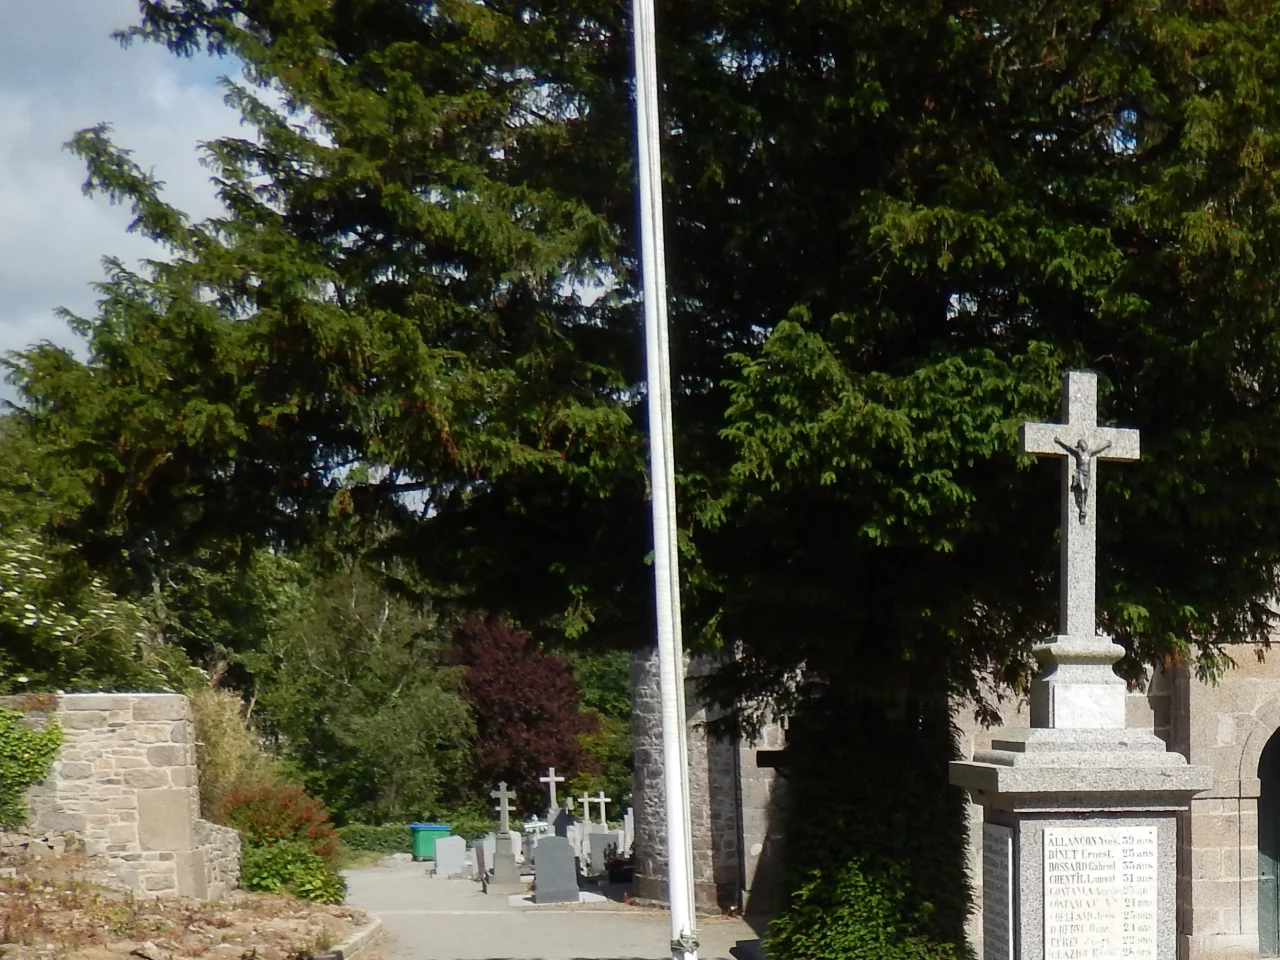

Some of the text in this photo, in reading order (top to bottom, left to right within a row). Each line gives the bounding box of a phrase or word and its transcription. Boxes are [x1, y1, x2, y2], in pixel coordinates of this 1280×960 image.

[1122, 849, 1135, 858] 25
[1048, 862, 1088, 872] BOSSARD
[1088, 861, 1116, 871] Gabriel
